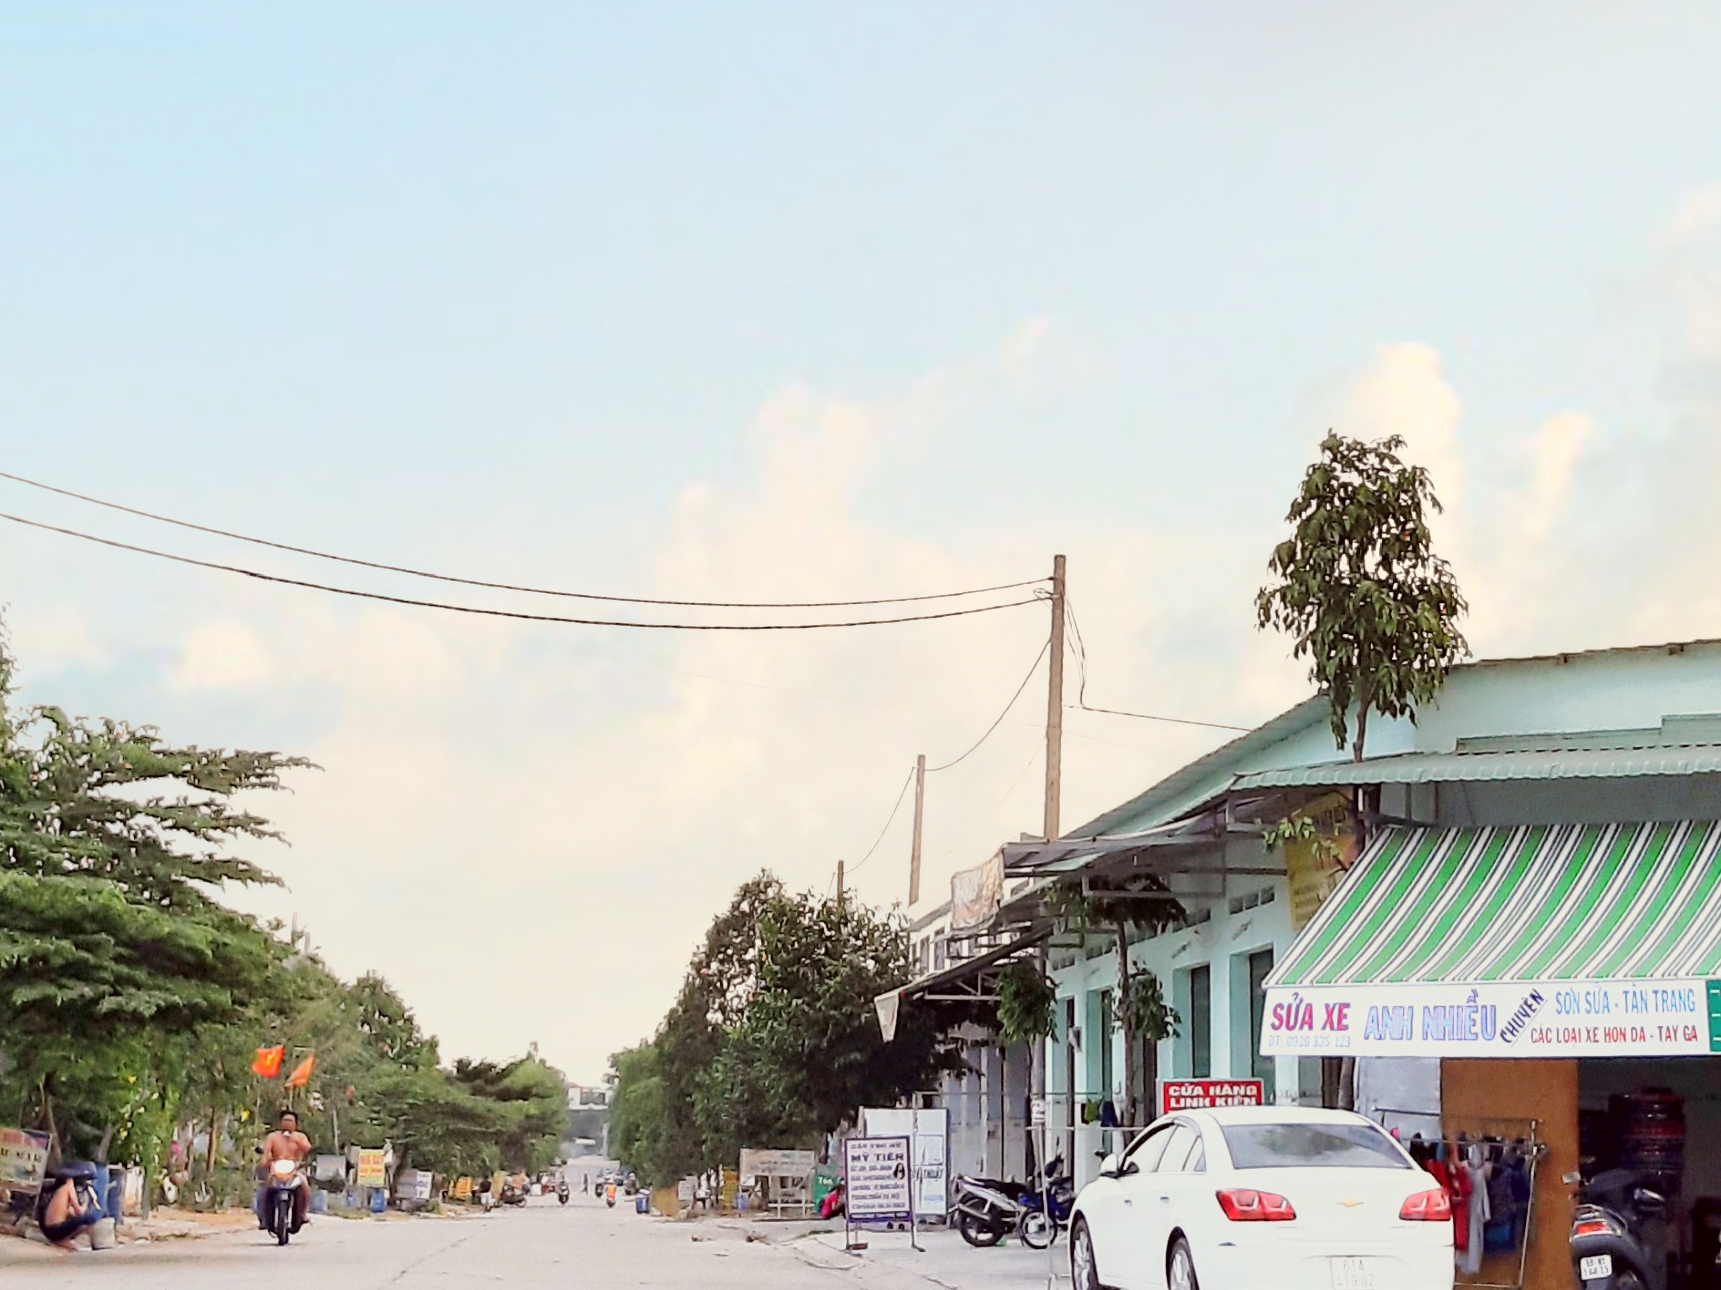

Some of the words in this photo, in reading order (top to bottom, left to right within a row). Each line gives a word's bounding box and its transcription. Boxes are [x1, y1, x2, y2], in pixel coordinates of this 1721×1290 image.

[1270, 991, 1313, 1032] SỬA
[1321, 1002, 1351, 1031] XE
[1653, 988, 1696, 1013] TRANG
[1364, 1006, 1414, 1040] ANH
[1585, 1027, 1600, 1043] XE
[1657, 1025, 1679, 1042] TAY
[1683, 1024, 1698, 1042] GA
[1170, 1096, 1211, 1108] LINH
